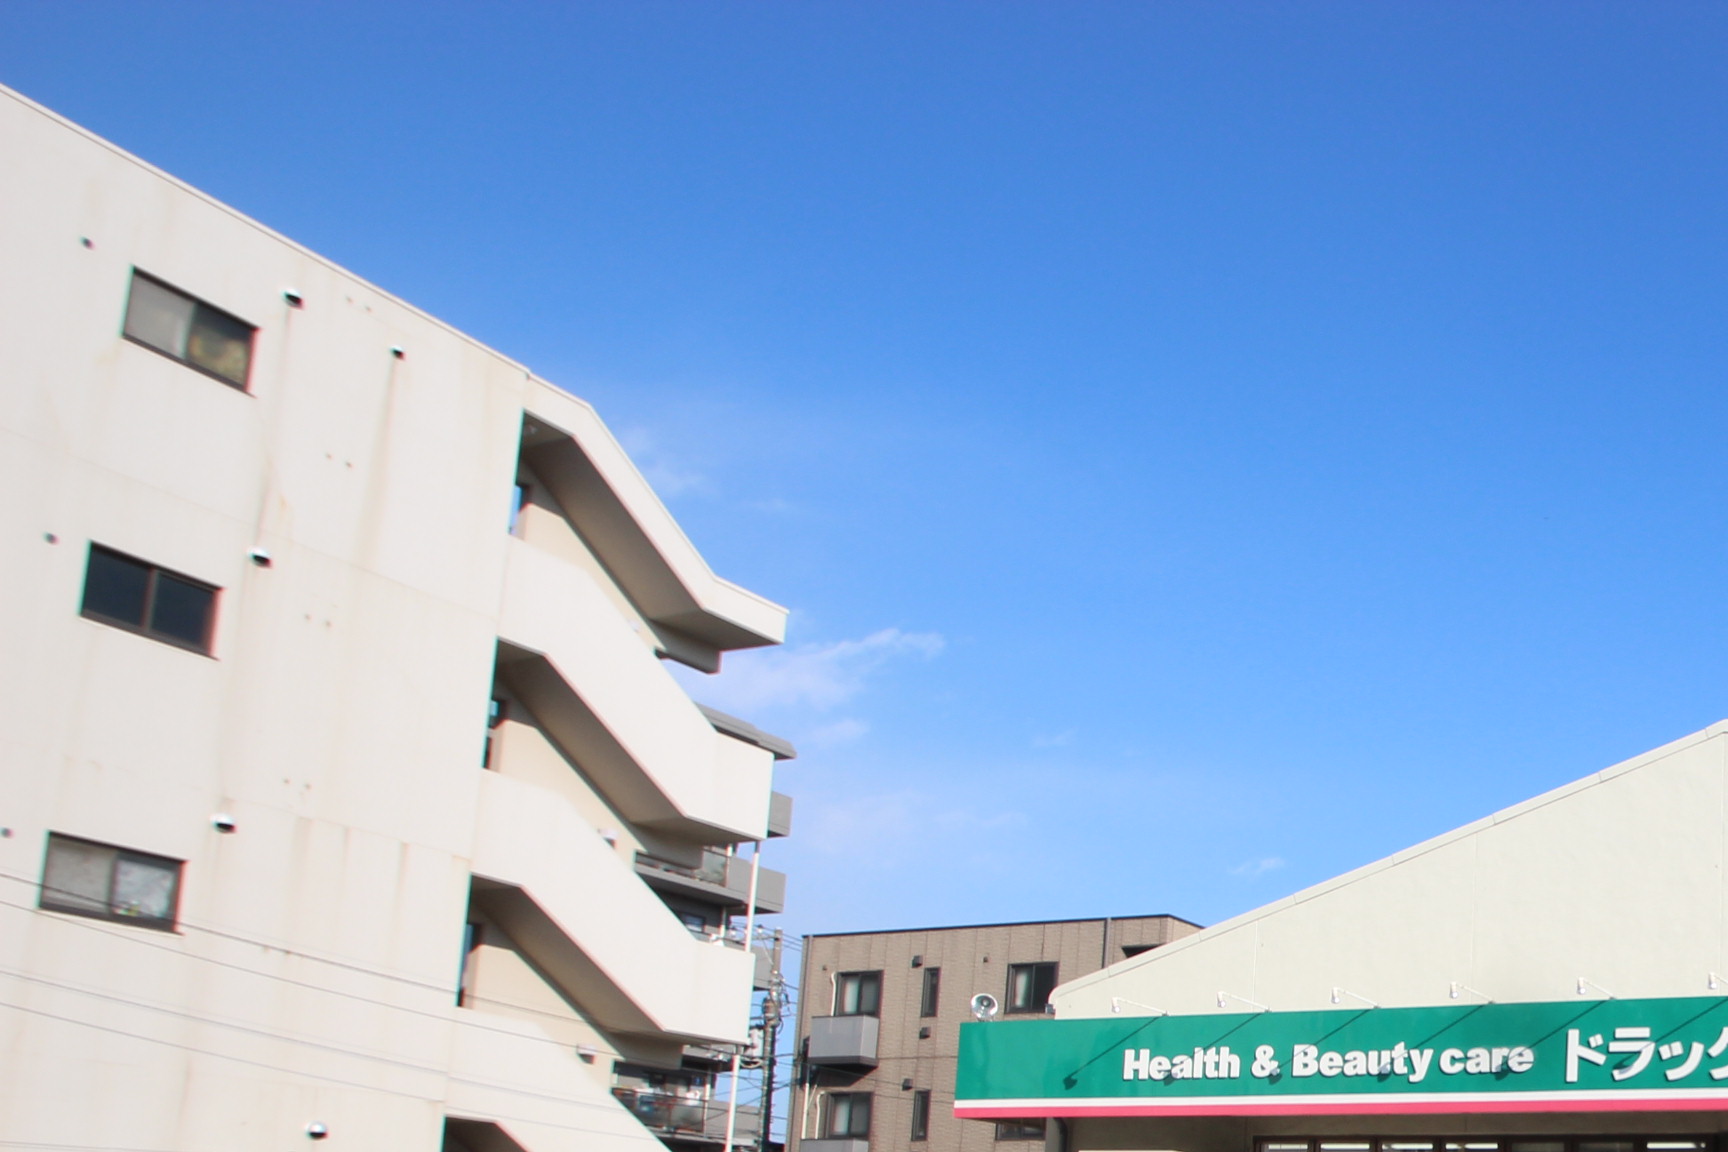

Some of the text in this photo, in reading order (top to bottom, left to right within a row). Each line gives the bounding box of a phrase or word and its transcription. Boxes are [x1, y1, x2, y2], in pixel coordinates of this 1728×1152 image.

[1122, 1042, 1535, 1083] Health & Beauty care
